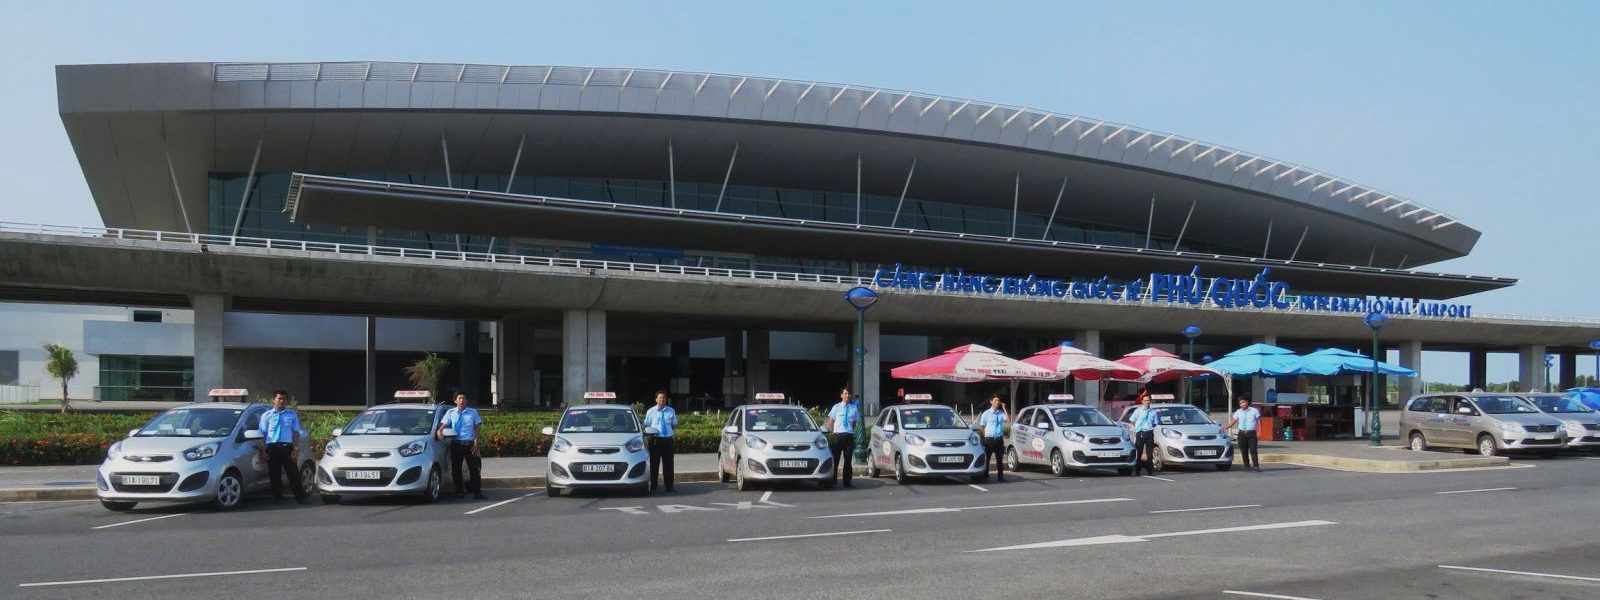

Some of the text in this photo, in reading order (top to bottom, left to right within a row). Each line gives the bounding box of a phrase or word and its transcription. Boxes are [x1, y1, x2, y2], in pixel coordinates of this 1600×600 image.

[1072, 275, 1121, 300] QUỐC
[1151, 265, 1203, 305] PHÚ
[1211, 267, 1291, 309] QUỐC
[1298, 296, 1411, 315] INTERNATIONAL
[1418, 303, 1472, 318] AIRPORT
[599, 501, 797, 514] TAXI
